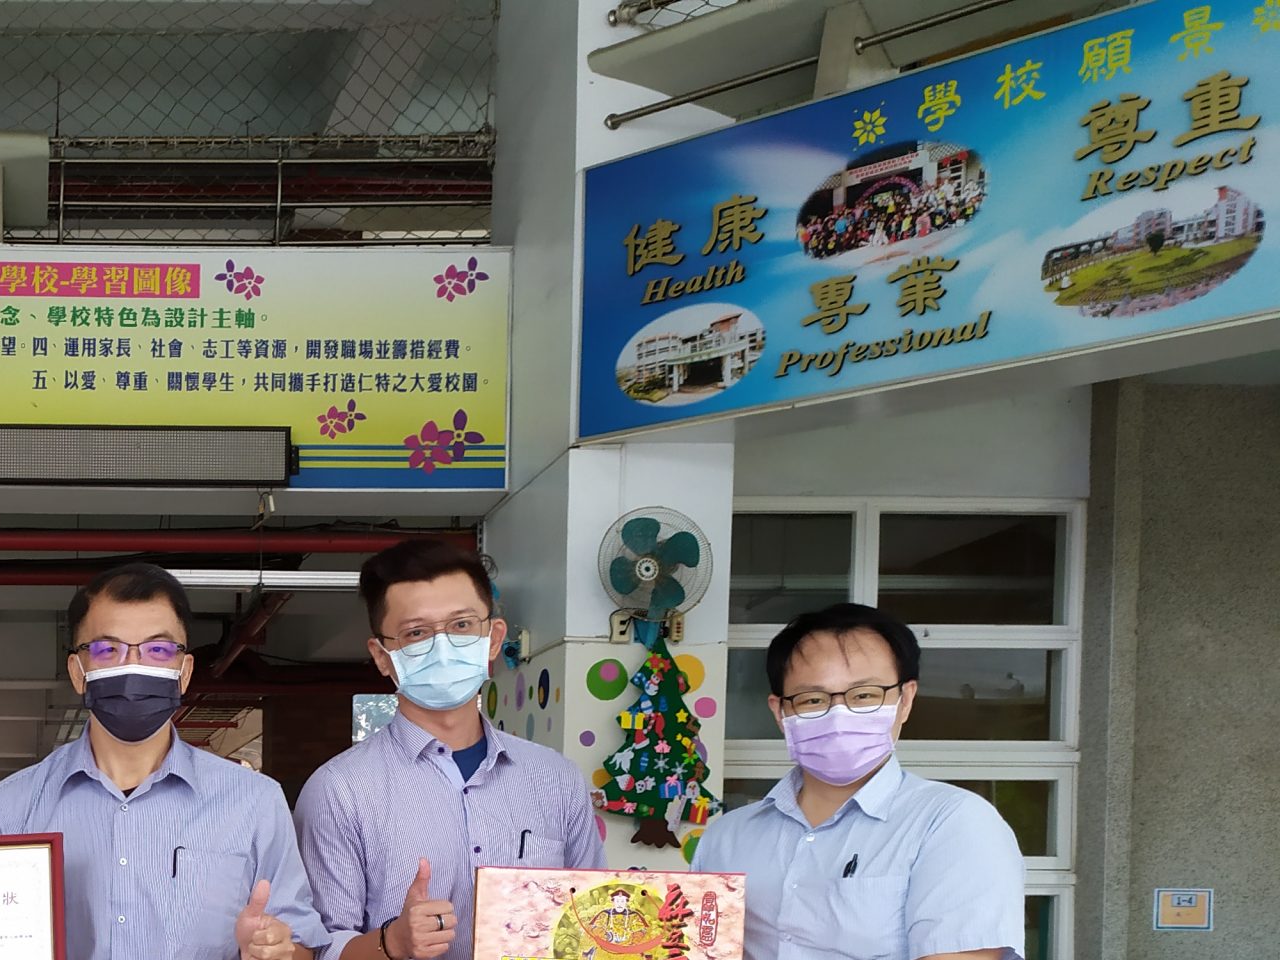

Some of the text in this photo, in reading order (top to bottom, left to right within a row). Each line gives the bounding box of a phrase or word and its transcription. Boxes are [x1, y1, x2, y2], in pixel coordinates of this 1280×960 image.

[917, 5, 1225, 132] 學校願景
[1074, 69, 1261, 164] 尊重
[1081, 136, 1257, 201] Respect
[623, 194, 768, 277] 健康
[640, 260, 745, 305] Health
[801, 256, 959, 336] 專業
[775, 312, 991, 378] Professional
